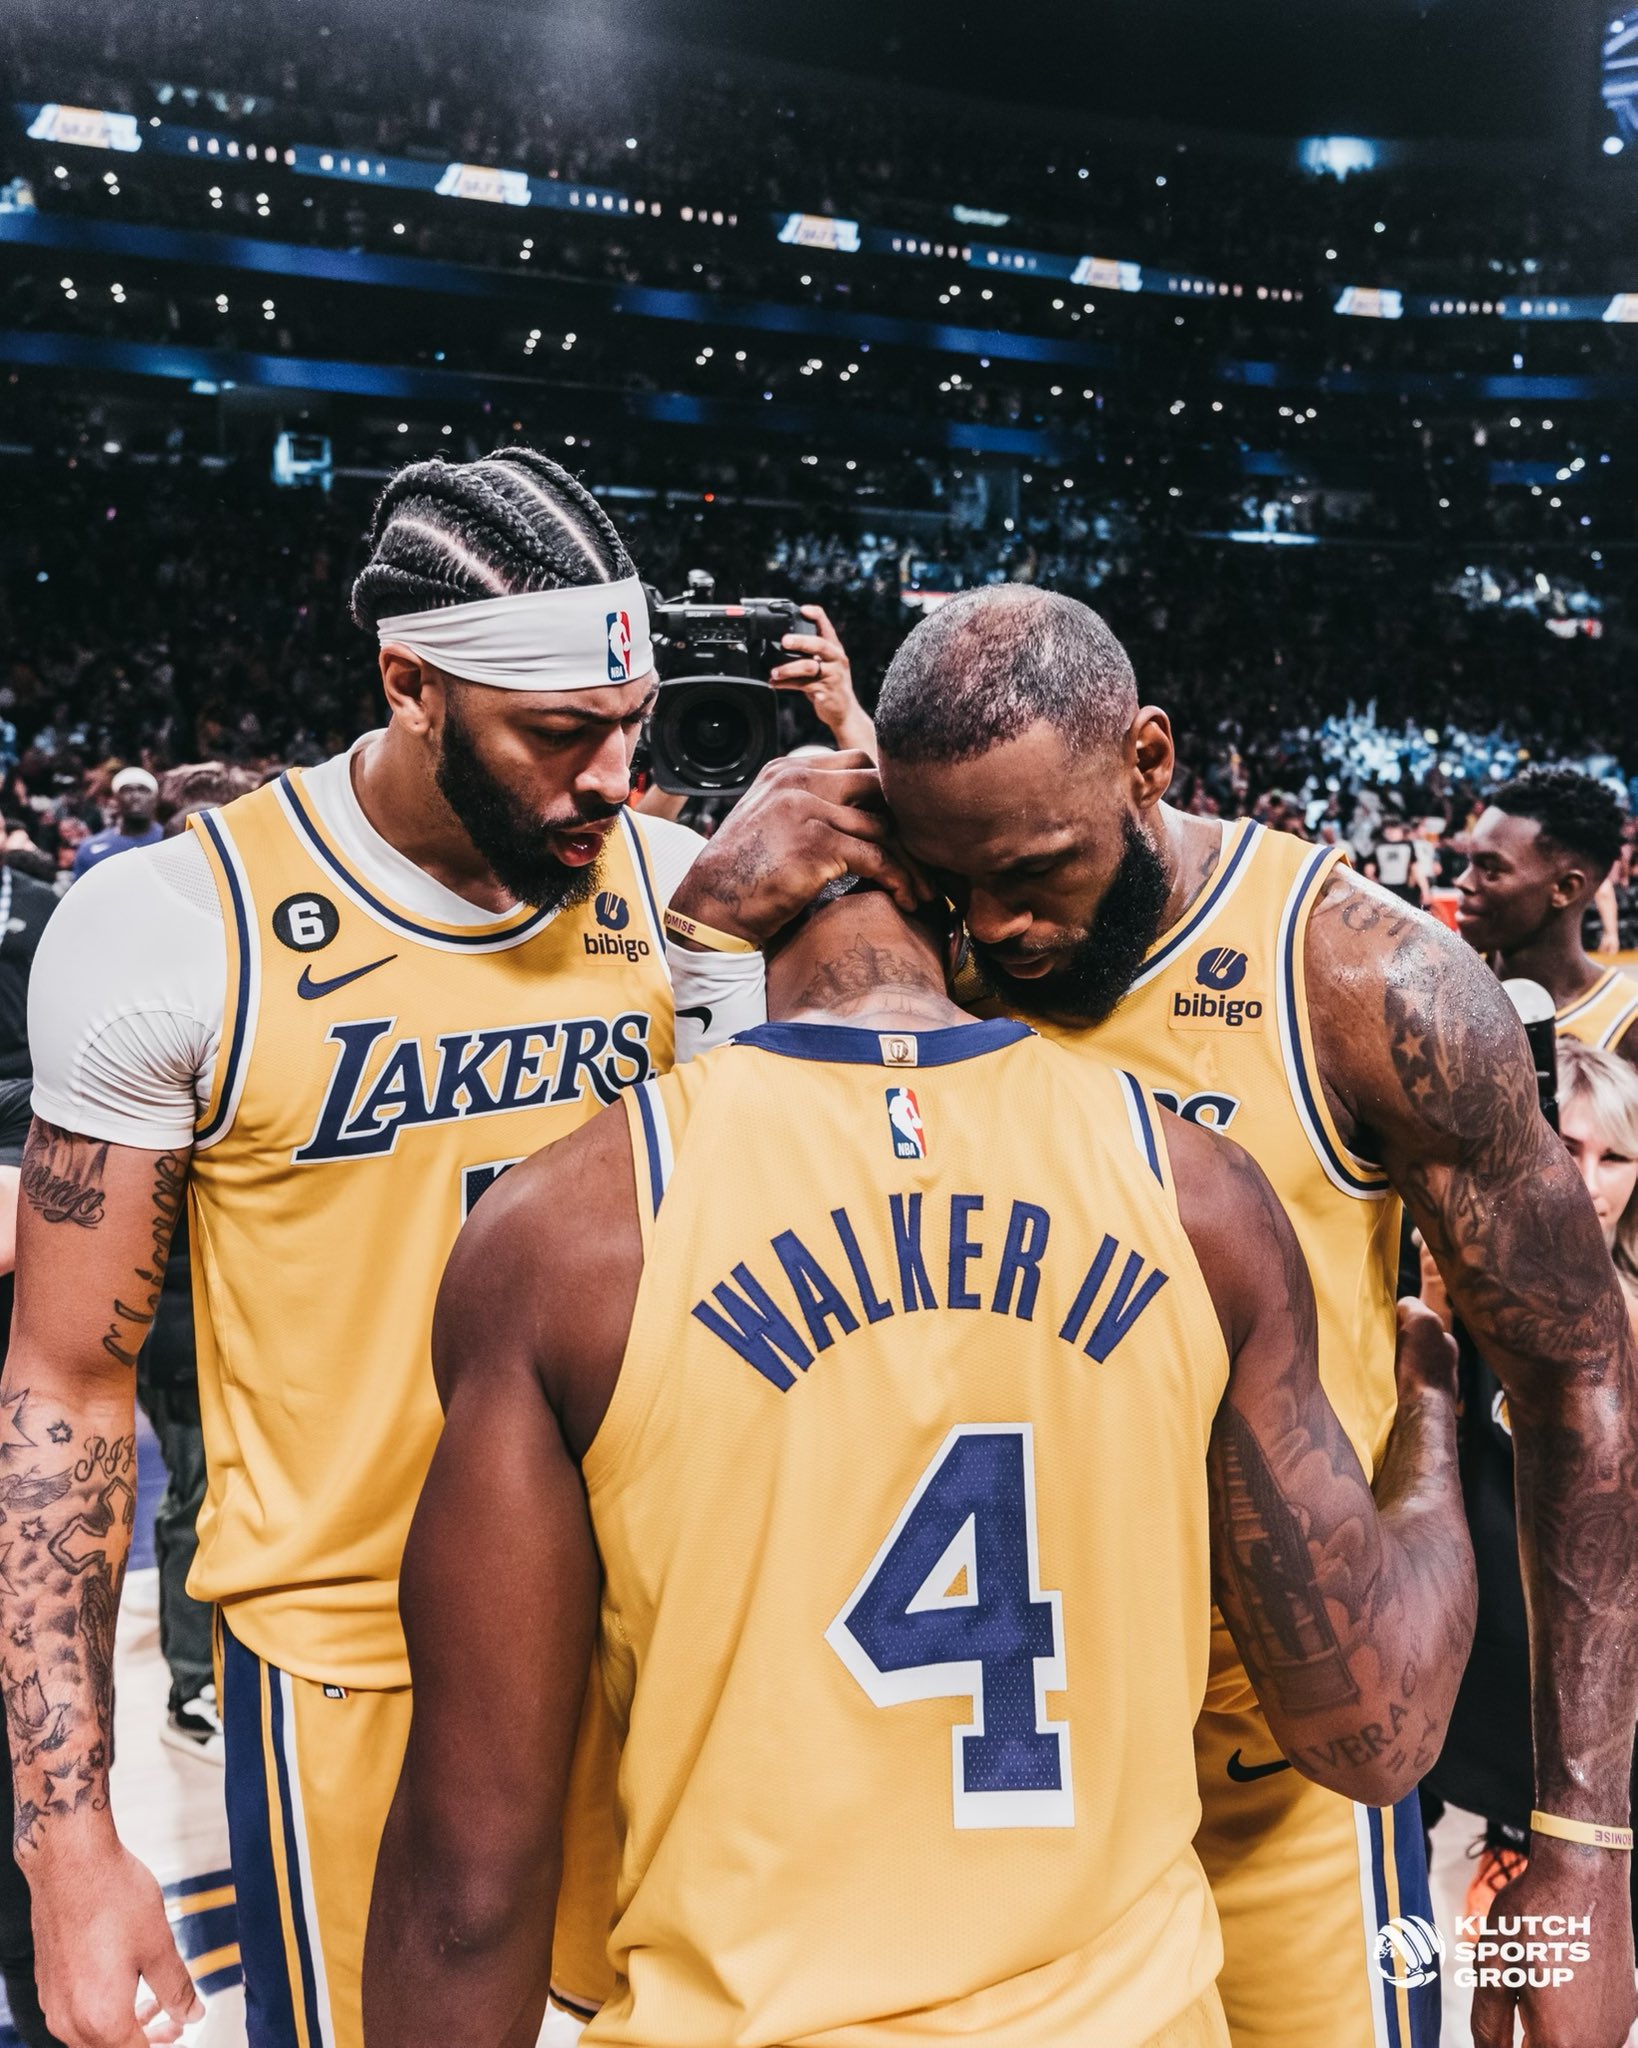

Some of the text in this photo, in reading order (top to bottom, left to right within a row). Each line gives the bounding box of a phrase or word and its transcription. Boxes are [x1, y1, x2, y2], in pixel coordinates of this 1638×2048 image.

[288, 901, 325, 945] 6
[664, 911, 697, 935] OMISE
[584, 933, 650, 962] bibigo
[1174, 992, 1263, 1026] bibigo
[289, 1010, 658, 1166] LAKERS
[897, 1142, 916, 1156] NBA
[691, 1192, 1169, 1393] WALKER IV
[824, 1422, 1075, 1829] 4
